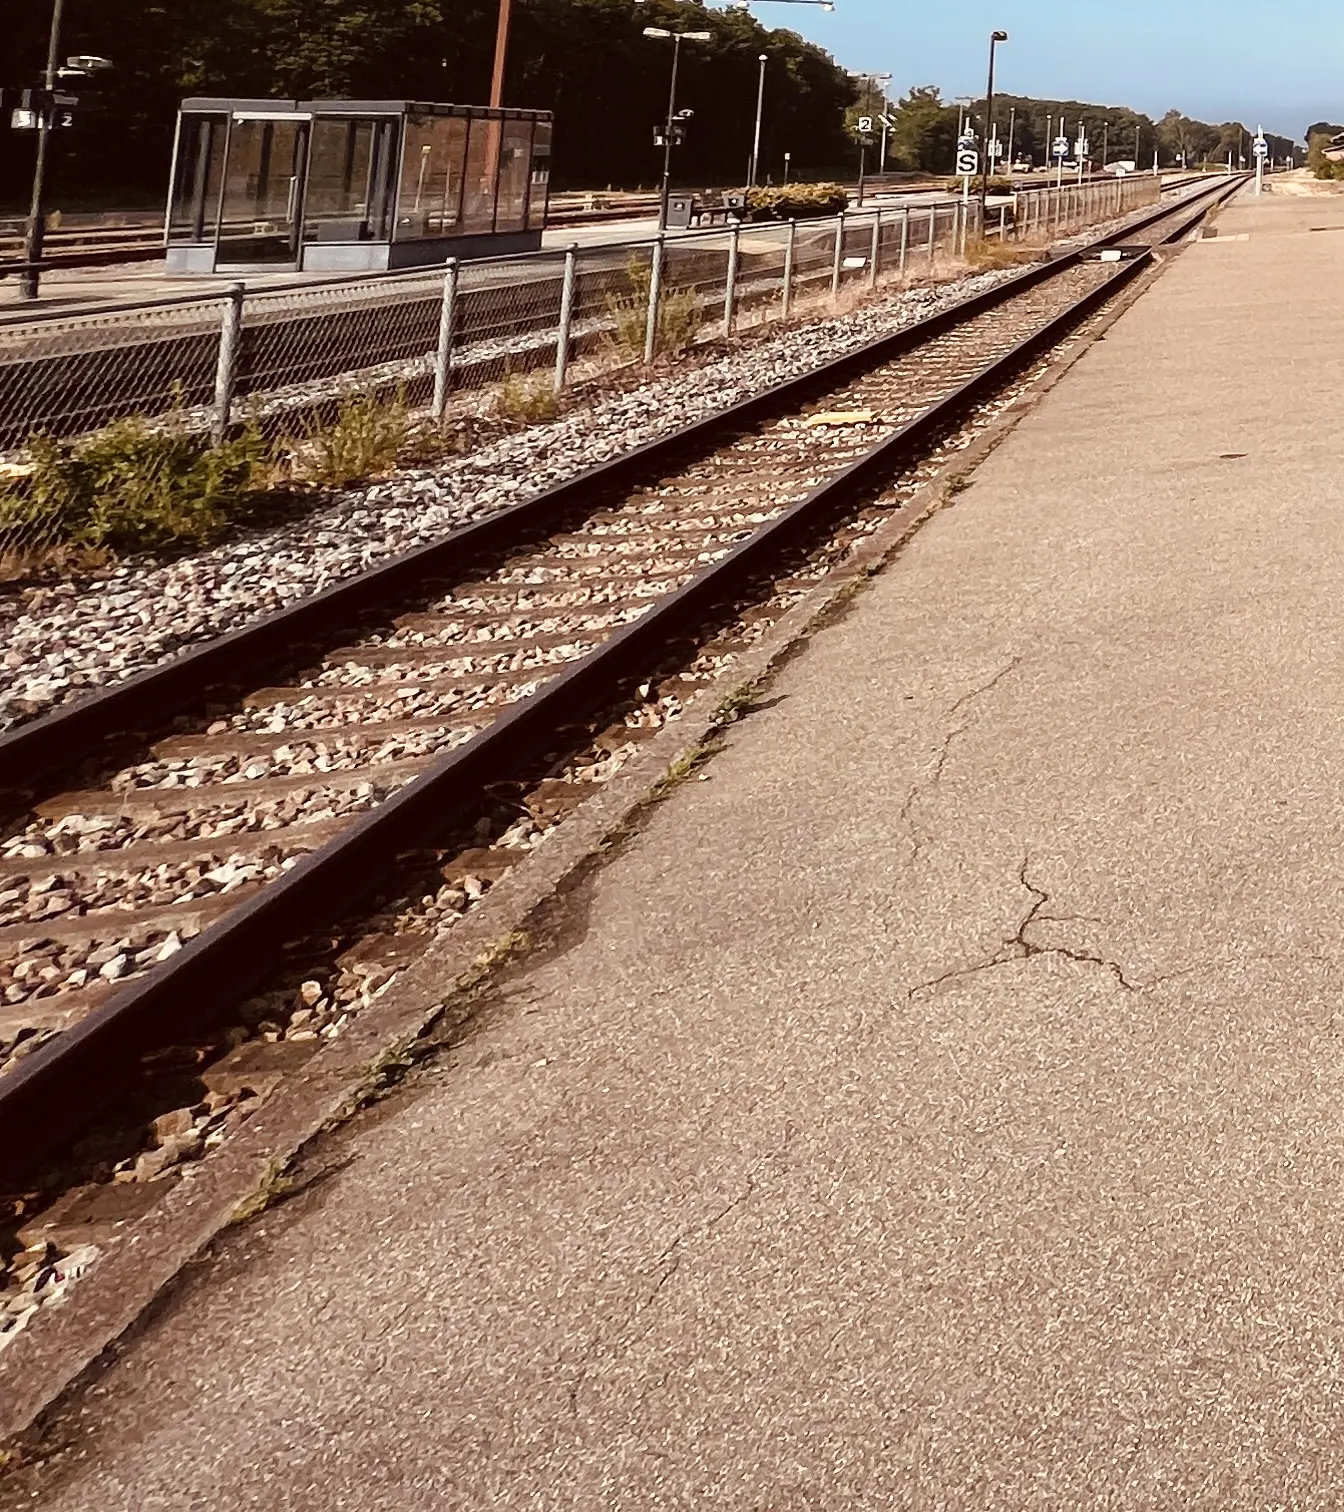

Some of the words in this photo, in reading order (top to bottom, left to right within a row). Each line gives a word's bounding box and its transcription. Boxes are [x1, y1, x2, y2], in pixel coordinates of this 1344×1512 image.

[61, 115, 73, 127] 2
[861, 119, 870, 130] 2
[958, 154, 975, 172] S
